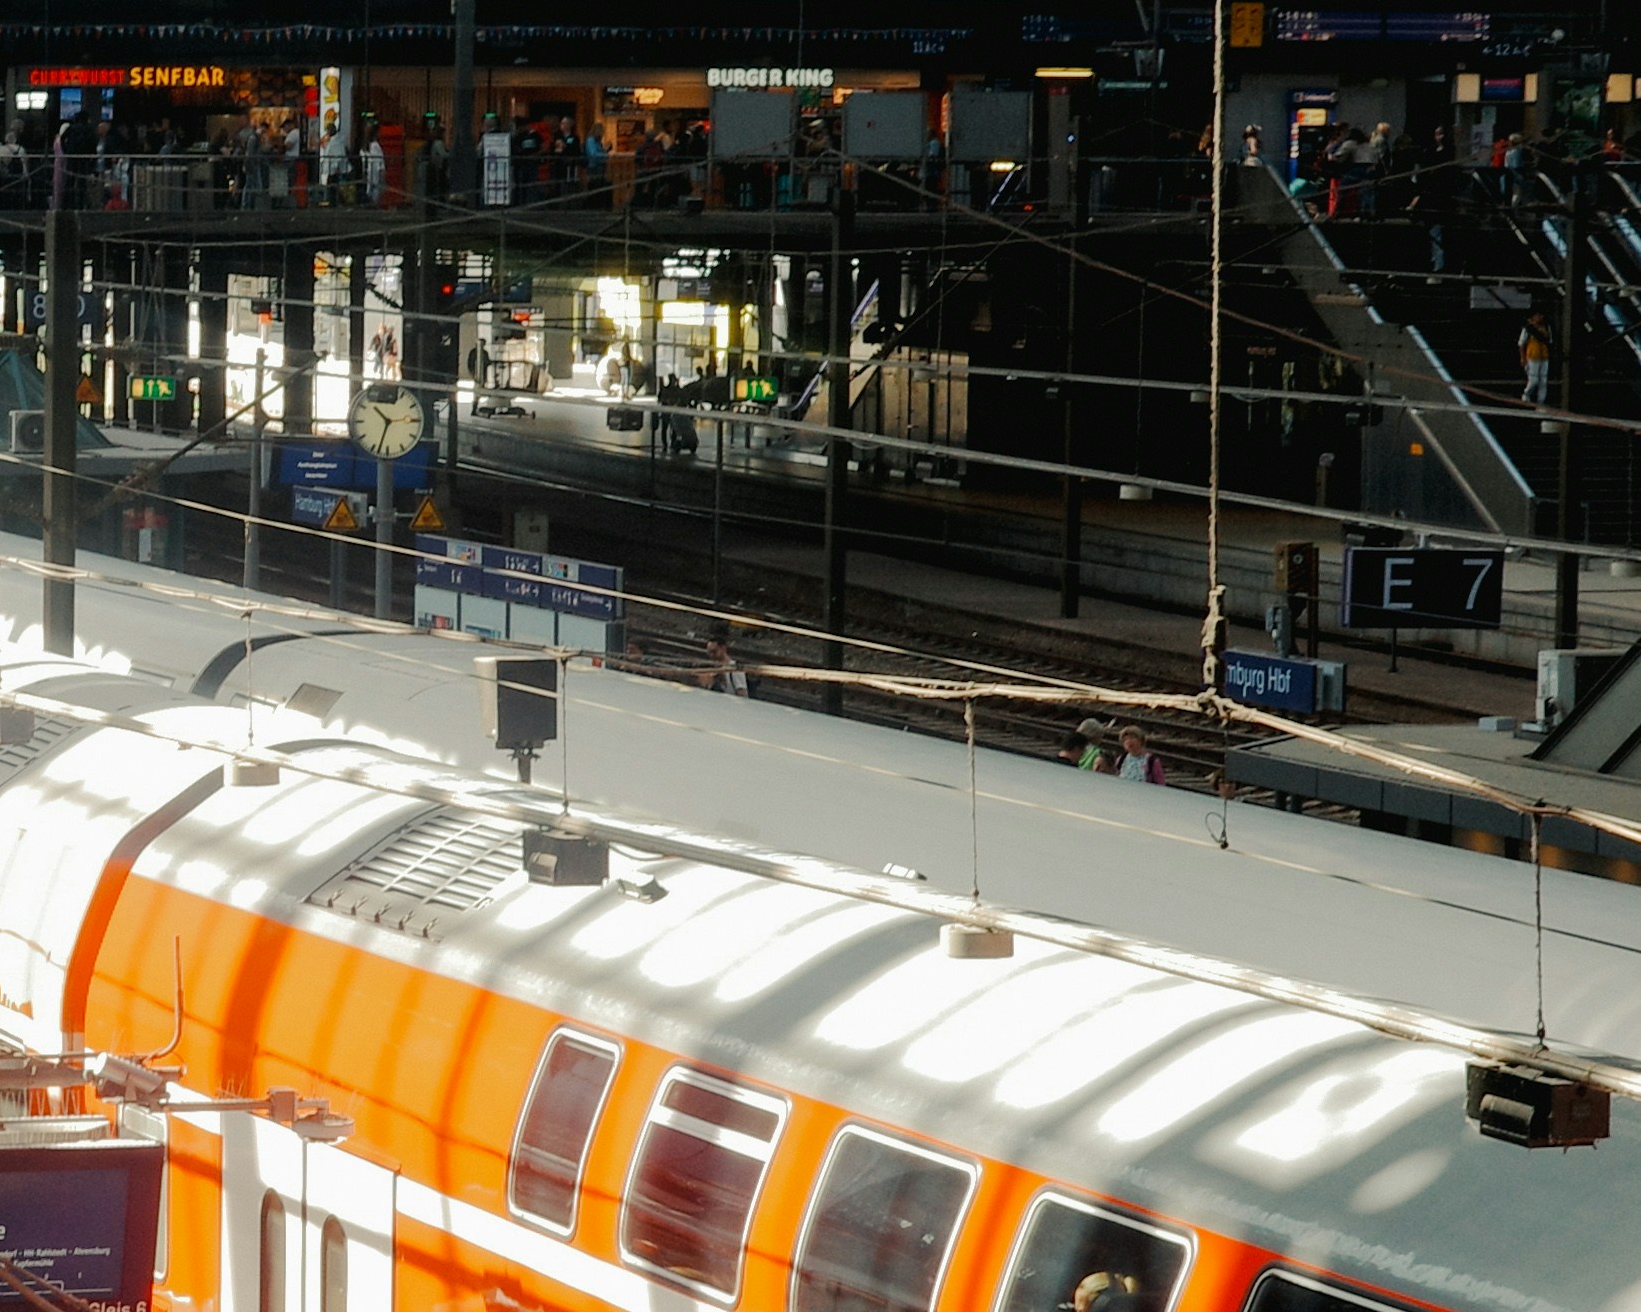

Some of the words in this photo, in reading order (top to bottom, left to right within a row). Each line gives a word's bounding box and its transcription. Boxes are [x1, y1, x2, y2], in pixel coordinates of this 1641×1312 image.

[129, 65, 226, 87] SENFBAR
[707, 67, 783, 87] BURGER
[786, 67, 835, 87] KING
[32, 292, 48, 319] 8
[294, 492, 323, 519] Hamburg
[1383, 557, 1415, 611] E
[1461, 557, 1494, 611] 7
[1226, 660, 1265, 695] mburg
[1267, 665, 1293, 695] Hbf
